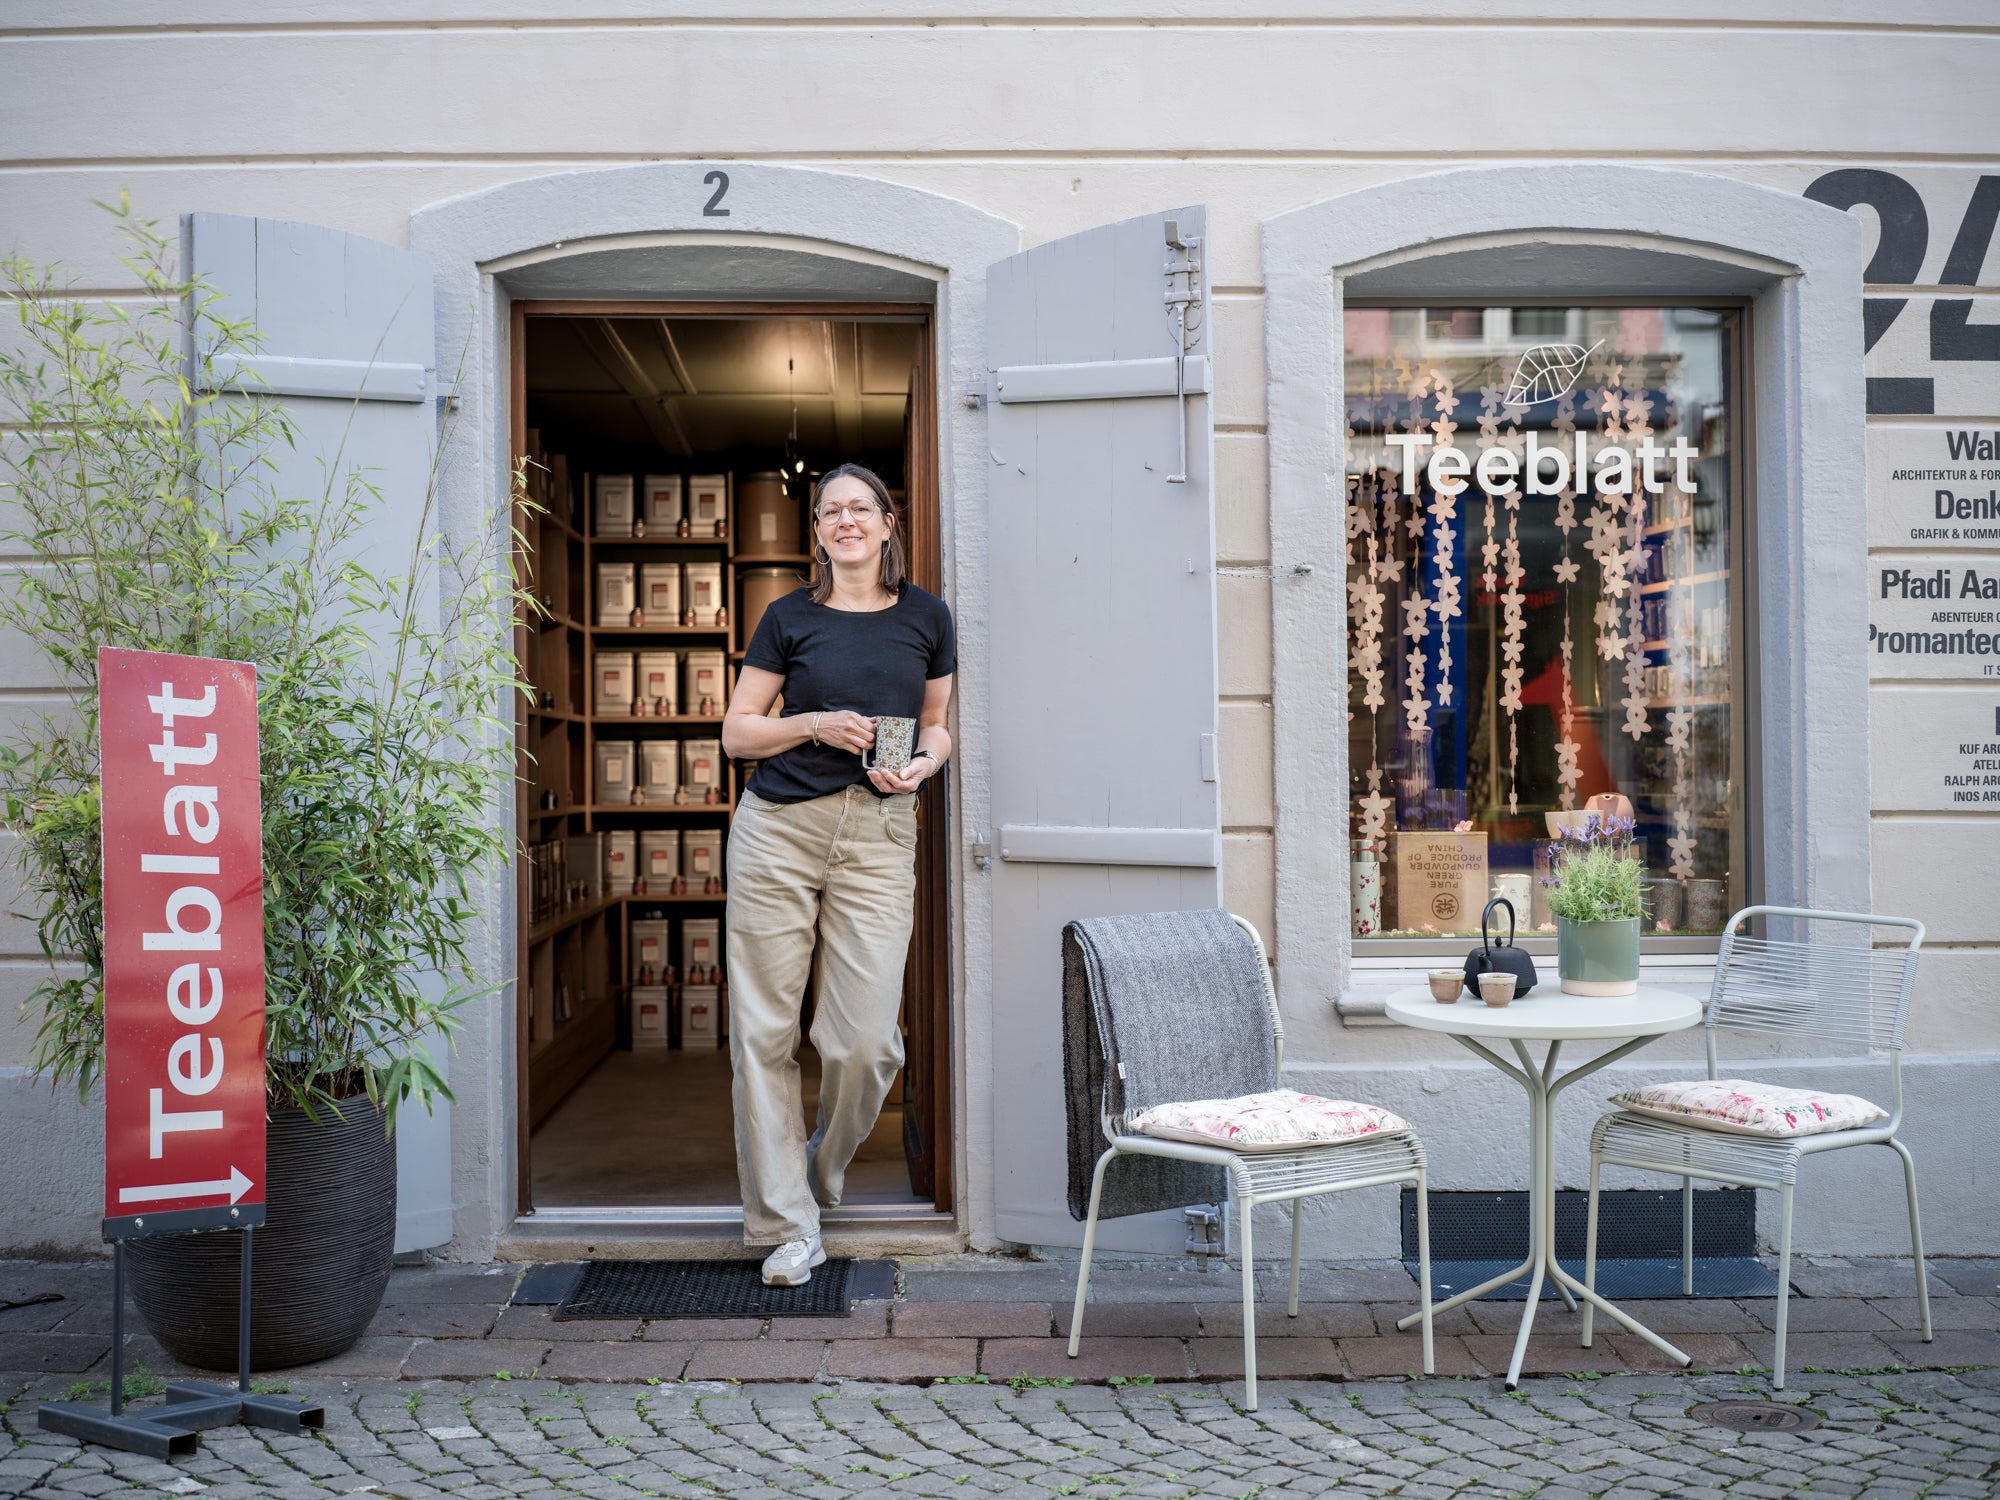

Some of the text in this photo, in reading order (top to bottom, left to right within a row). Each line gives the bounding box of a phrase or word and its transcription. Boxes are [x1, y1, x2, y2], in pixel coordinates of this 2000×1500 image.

[703, 170, 730, 217] 2
[1385, 430, 1699, 496] Teeblatt
[1892, 469, 1967, 481] ARCHITEKTUR
[1969, 469, 1978, 480] &
[1935, 490, 2000, 520] Denk
[1910, 528, 2000, 540] GRAFIK & KOMM
[1881, 569, 2000, 600] Pfadi Aa
[1931, 612, 1994, 623] ABENTEUER
[1984, 665, 1994, 676] IT
[1960, 744, 1981, 755] KUF
[1944, 775, 1980, 786] RALPH
[1954, 791, 1980, 802] INOS
[1427, 844, 1463, 853] CHINA
[1408, 853, 1482, 862] PRODUCE OF
[1409, 862, 1481, 871] GUNPOWDER
[1427, 871, 1463, 880] GREEN
[1430, 881, 1459, 889] PURE
[141, 681, 225, 1160] Teeblatt
